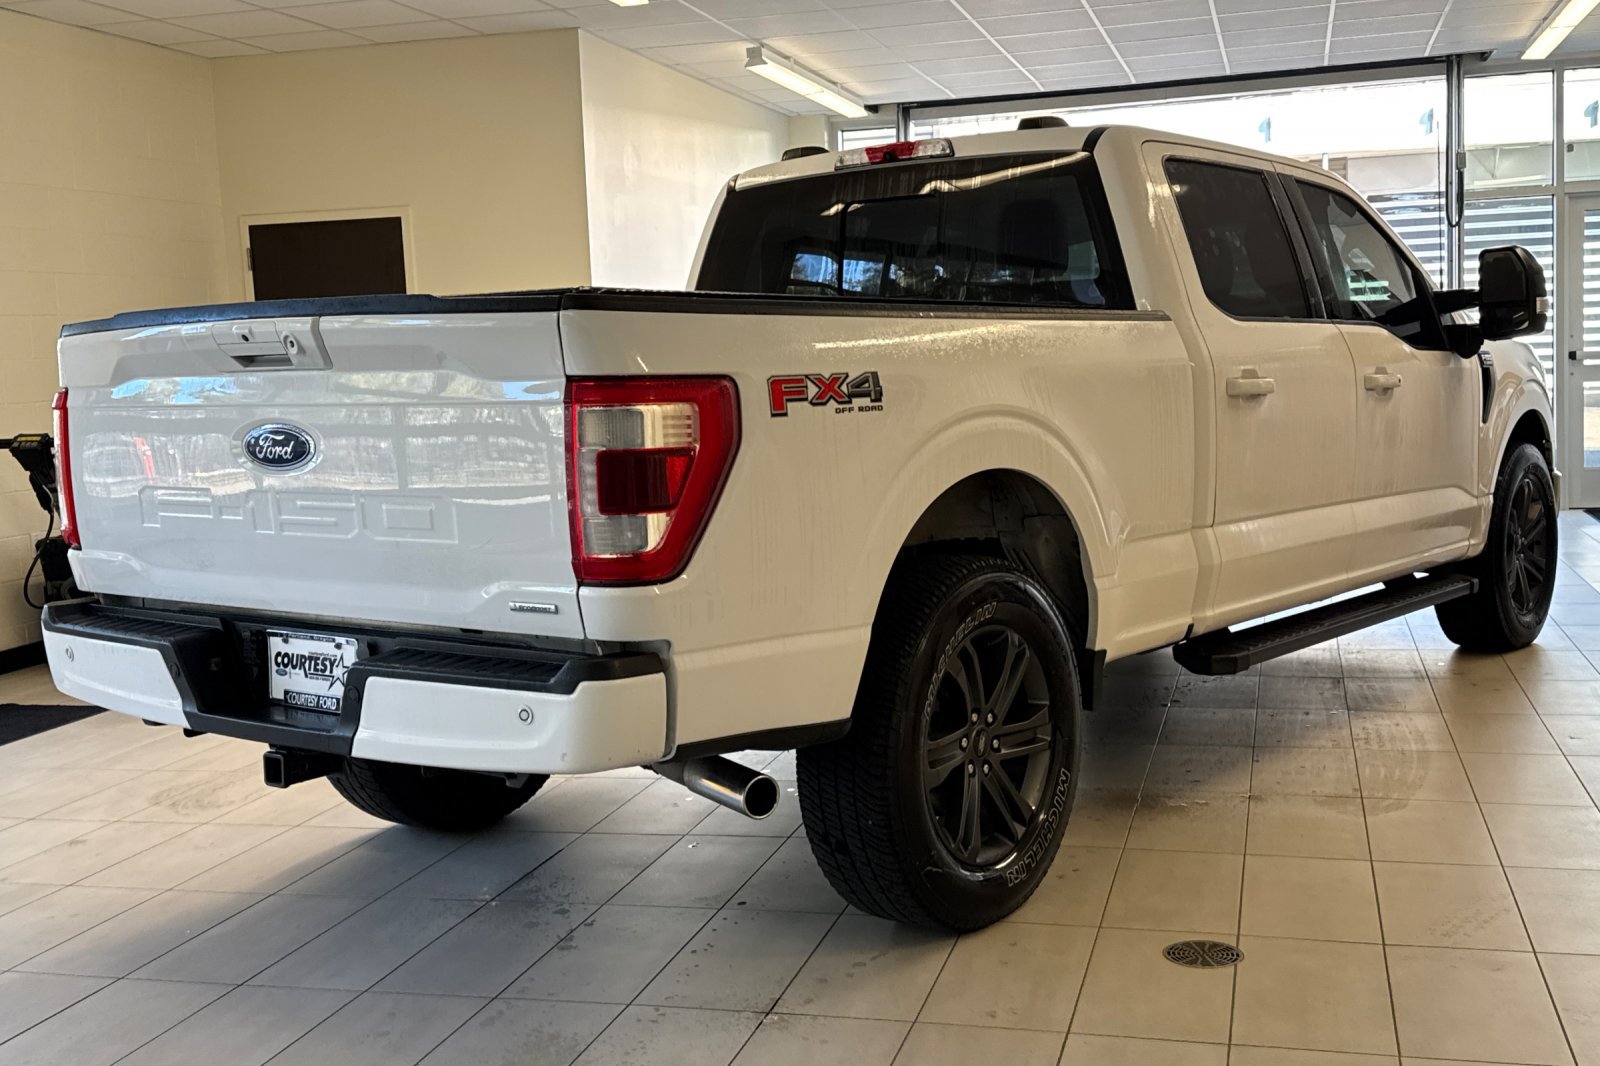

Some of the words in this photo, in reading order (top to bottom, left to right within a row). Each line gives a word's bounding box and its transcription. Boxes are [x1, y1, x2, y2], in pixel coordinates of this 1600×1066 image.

[767, 371, 883, 417] FX4
[858, 405, 883, 413] ROAD
[255, 433, 294, 460] Ford
[138, 485, 459, 543] F-150
[274, 651, 337, 678] COURTESY
[923, 601, 997, 722] MICHELIN
[287, 693, 318, 707] COURTESY
[319, 697, 337, 710] FORD
[1007, 767, 1071, 888] MICHELIN
